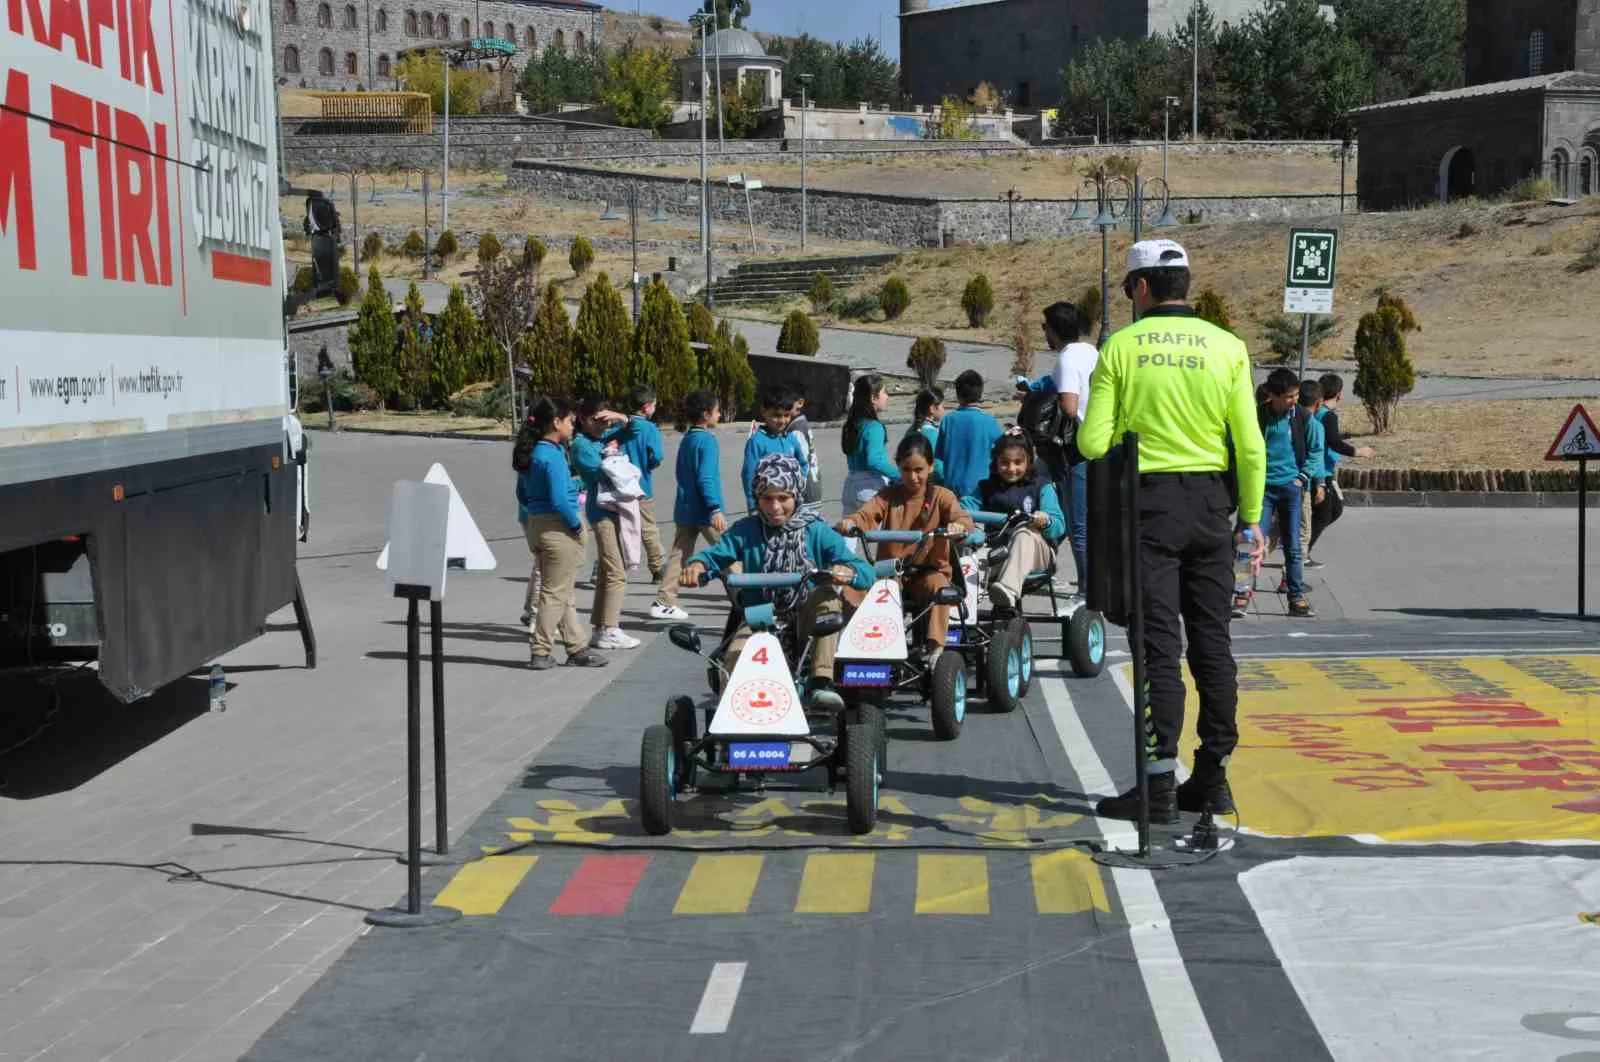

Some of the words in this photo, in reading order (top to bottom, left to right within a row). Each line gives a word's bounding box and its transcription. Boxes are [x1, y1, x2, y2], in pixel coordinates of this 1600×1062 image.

[49, 83, 173, 287] TIRI
[29, 371, 105, 404] www.egm.gov.tr
[118, 365, 183, 399] www.trafik.gov.tr
[875, 589, 889, 603] 2
[751, 647, 768, 664] 4
[747, 750, 757, 758] A
